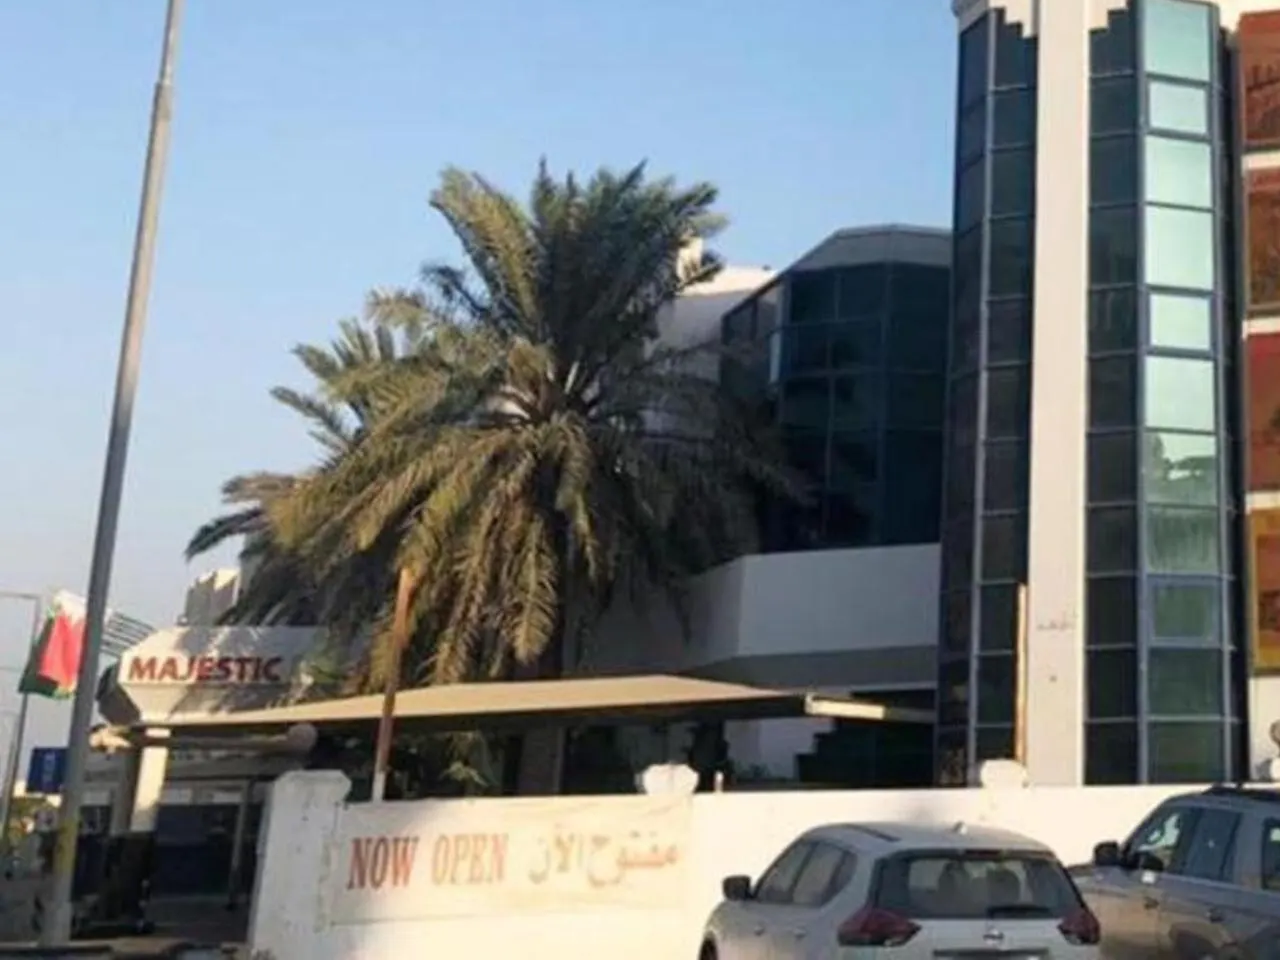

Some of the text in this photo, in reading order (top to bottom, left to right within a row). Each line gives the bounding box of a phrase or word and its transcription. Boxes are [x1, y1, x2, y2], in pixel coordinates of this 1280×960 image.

[128, 655, 282, 682] MAJESTIC
[347, 833, 510, 890] NOW OPEN
